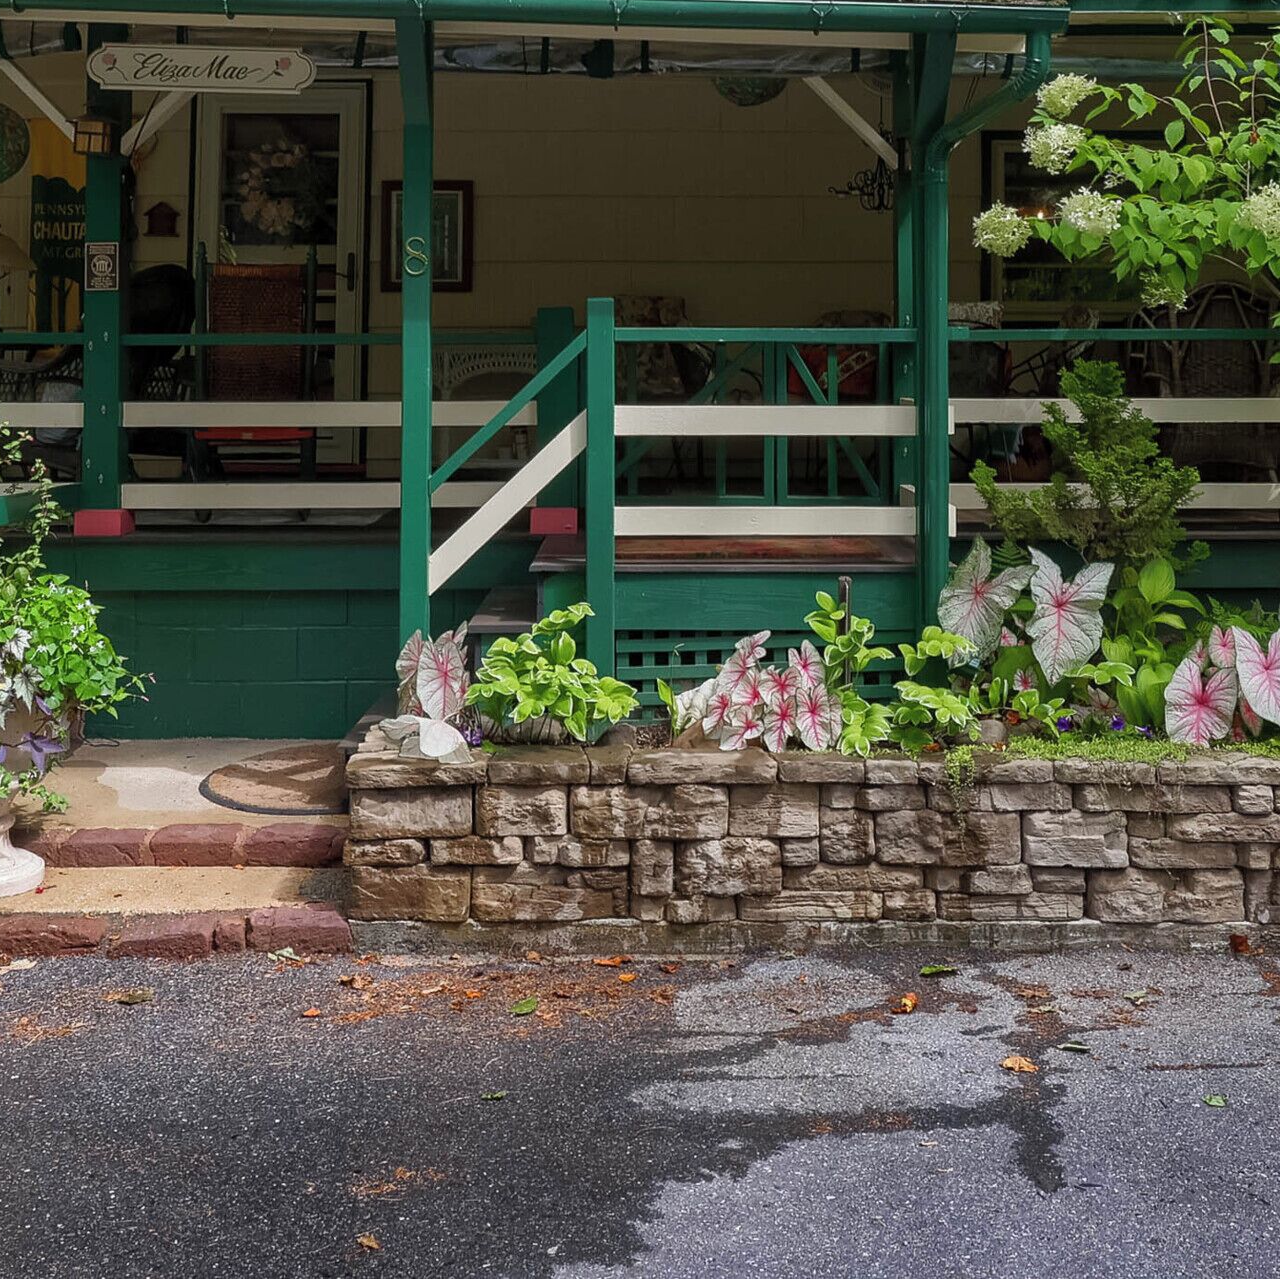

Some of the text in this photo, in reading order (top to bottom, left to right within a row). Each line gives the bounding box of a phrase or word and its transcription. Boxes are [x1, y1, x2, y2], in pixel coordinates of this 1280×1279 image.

[132, 52, 263, 83] Eliza Mae
[33, 202, 87, 216] PENNSYL
[32, 220, 87, 241] CHAUTA
[403, 236, 429, 276] 8
